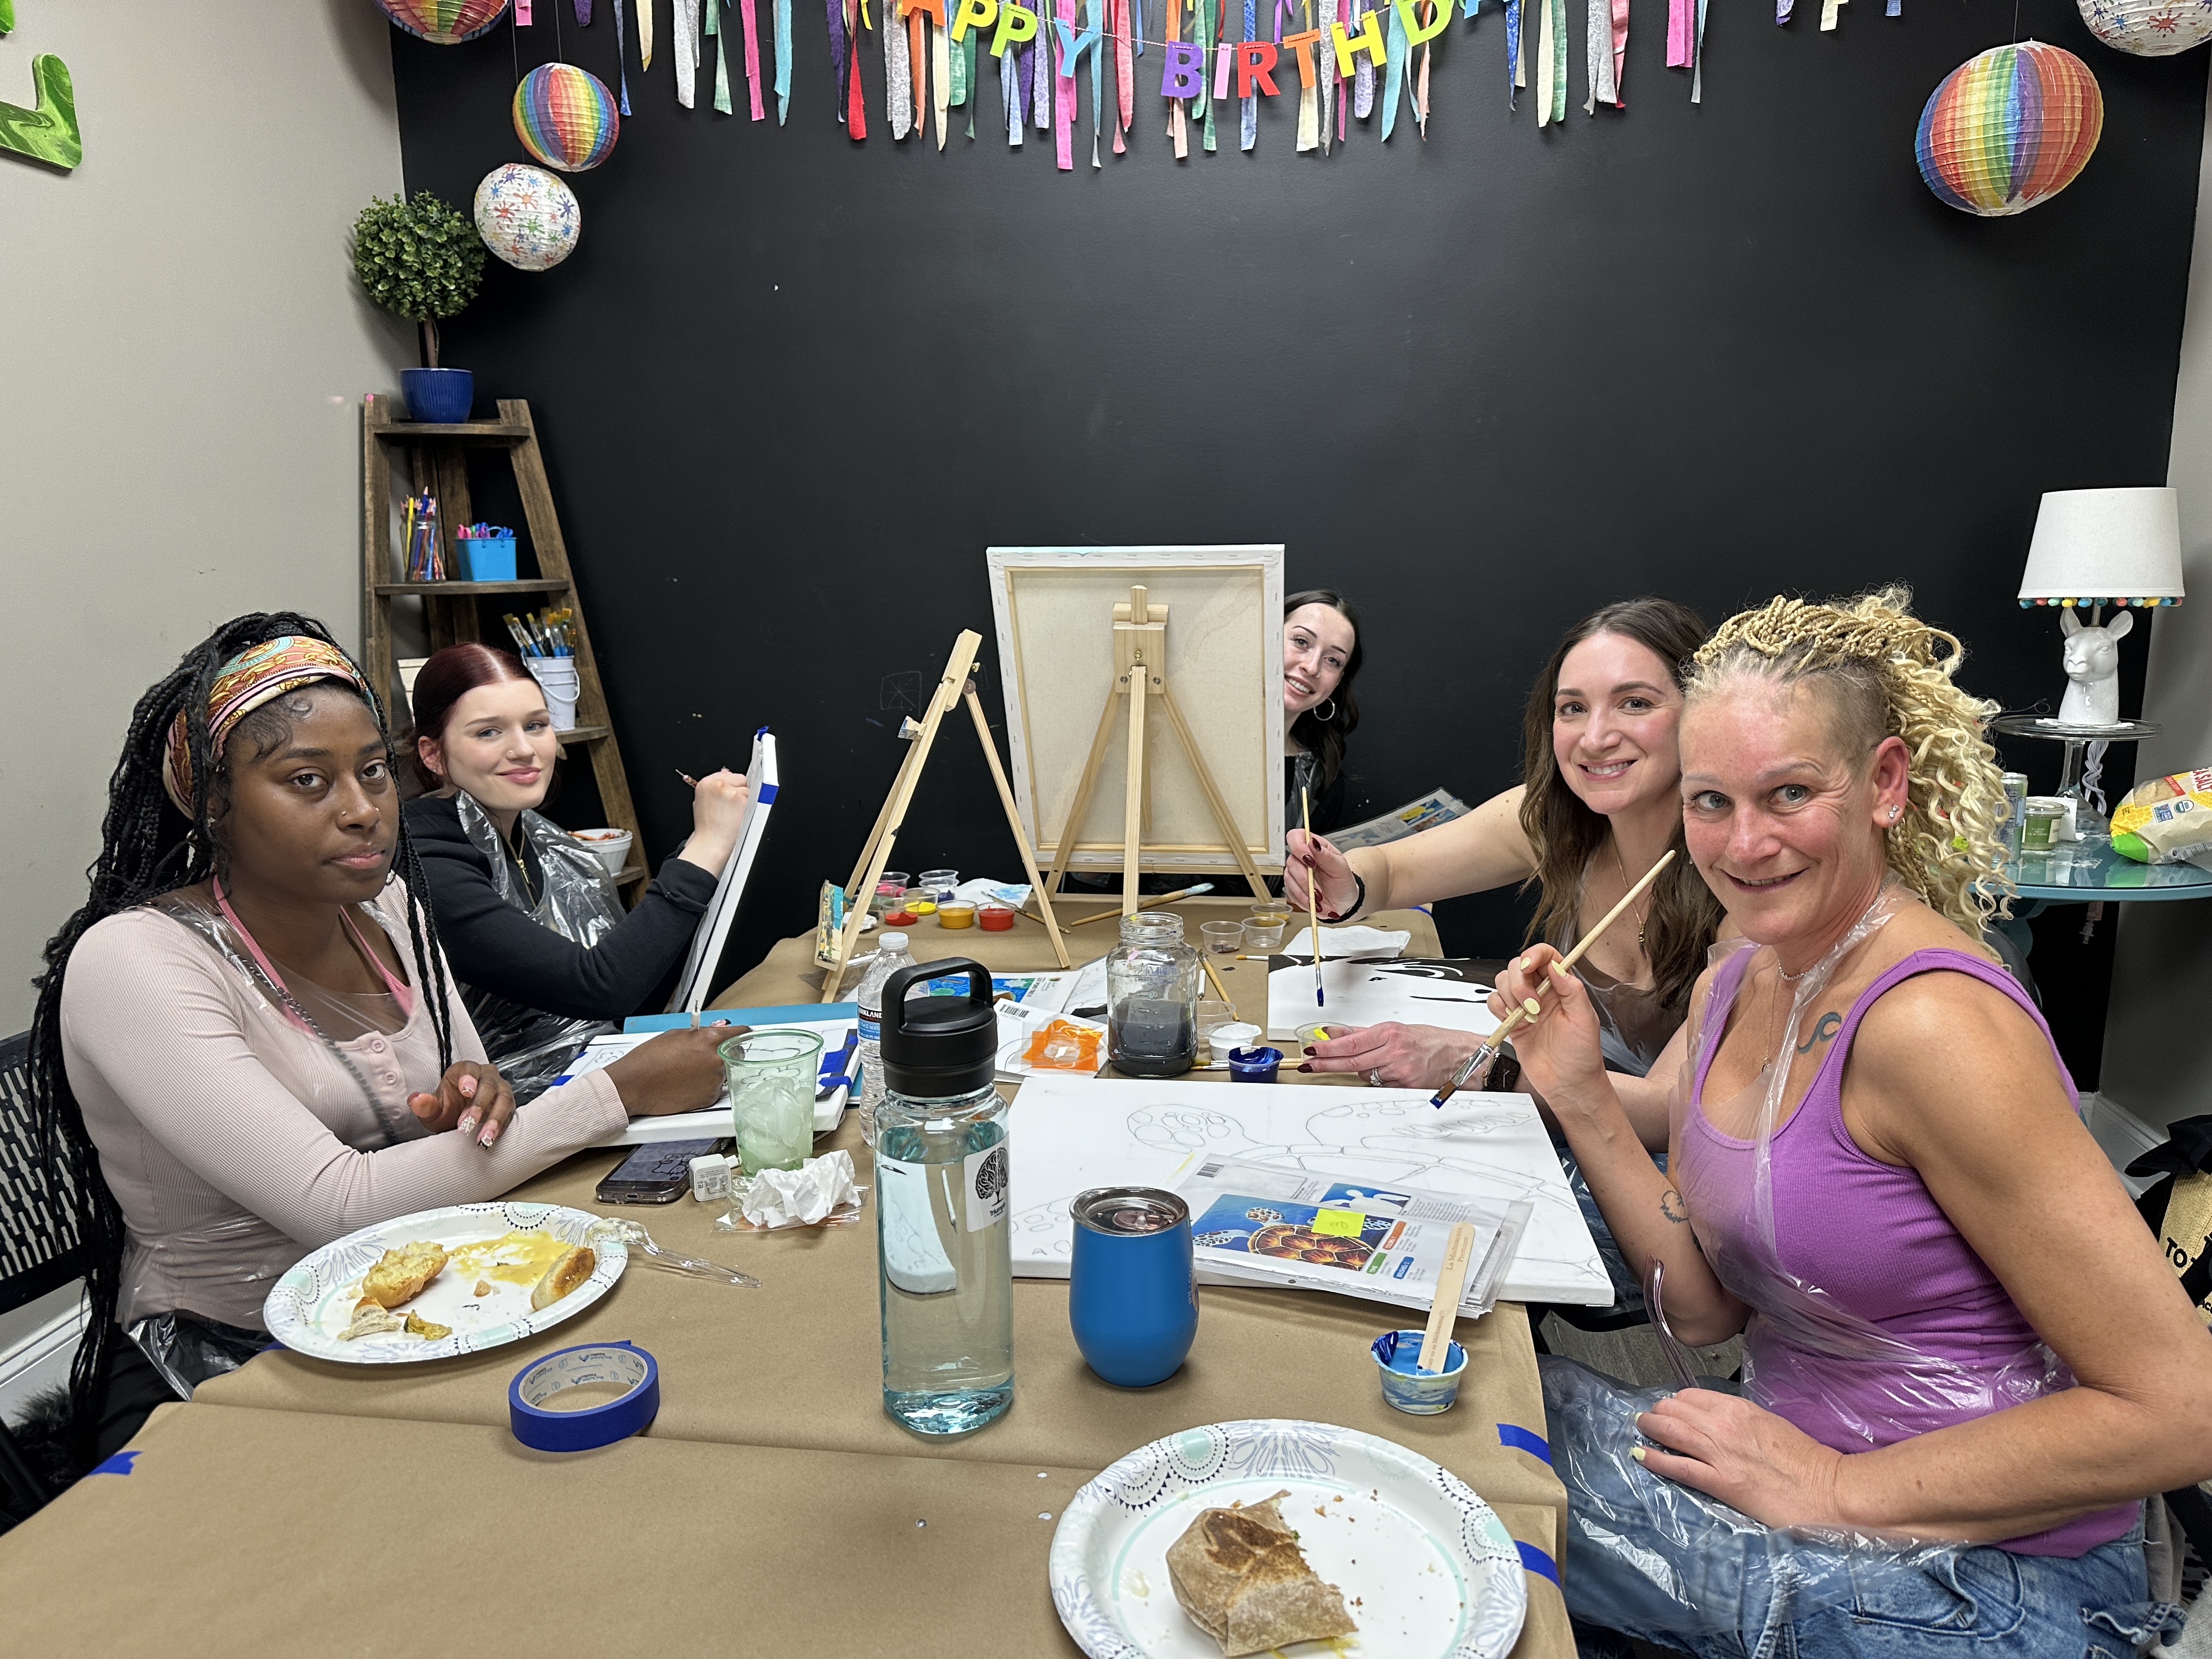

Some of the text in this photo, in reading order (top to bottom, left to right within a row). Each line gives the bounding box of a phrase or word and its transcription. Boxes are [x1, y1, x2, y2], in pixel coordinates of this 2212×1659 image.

[1161, 0, 1479, 99] BIRTHD
[1446, 1227, 1463, 1271] La Michoacana
[1457, 1237, 1469, 1263] Premium
